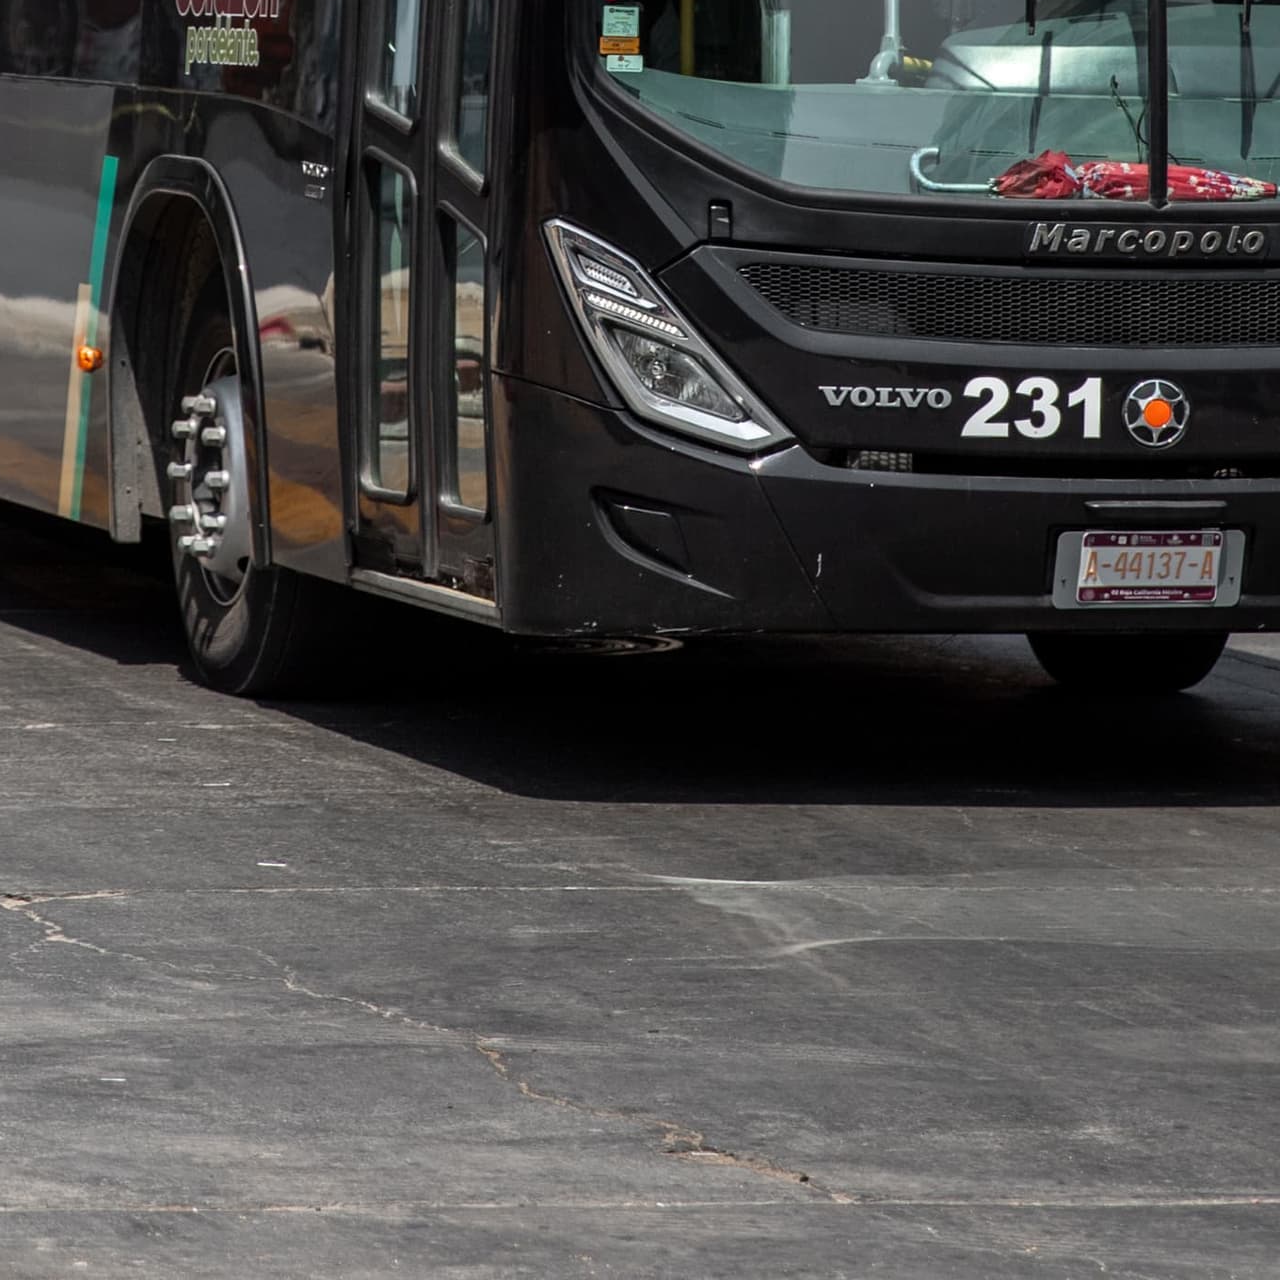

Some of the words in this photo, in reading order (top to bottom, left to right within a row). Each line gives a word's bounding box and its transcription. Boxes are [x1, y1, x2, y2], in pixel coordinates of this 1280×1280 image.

[1028, 222, 1265, 257] Marcopolo
[818, 385, 953, 410] VOLVO
[960, 376, 1103, 439] 231
[1084, 550, 1214, 582] A-44137-A
